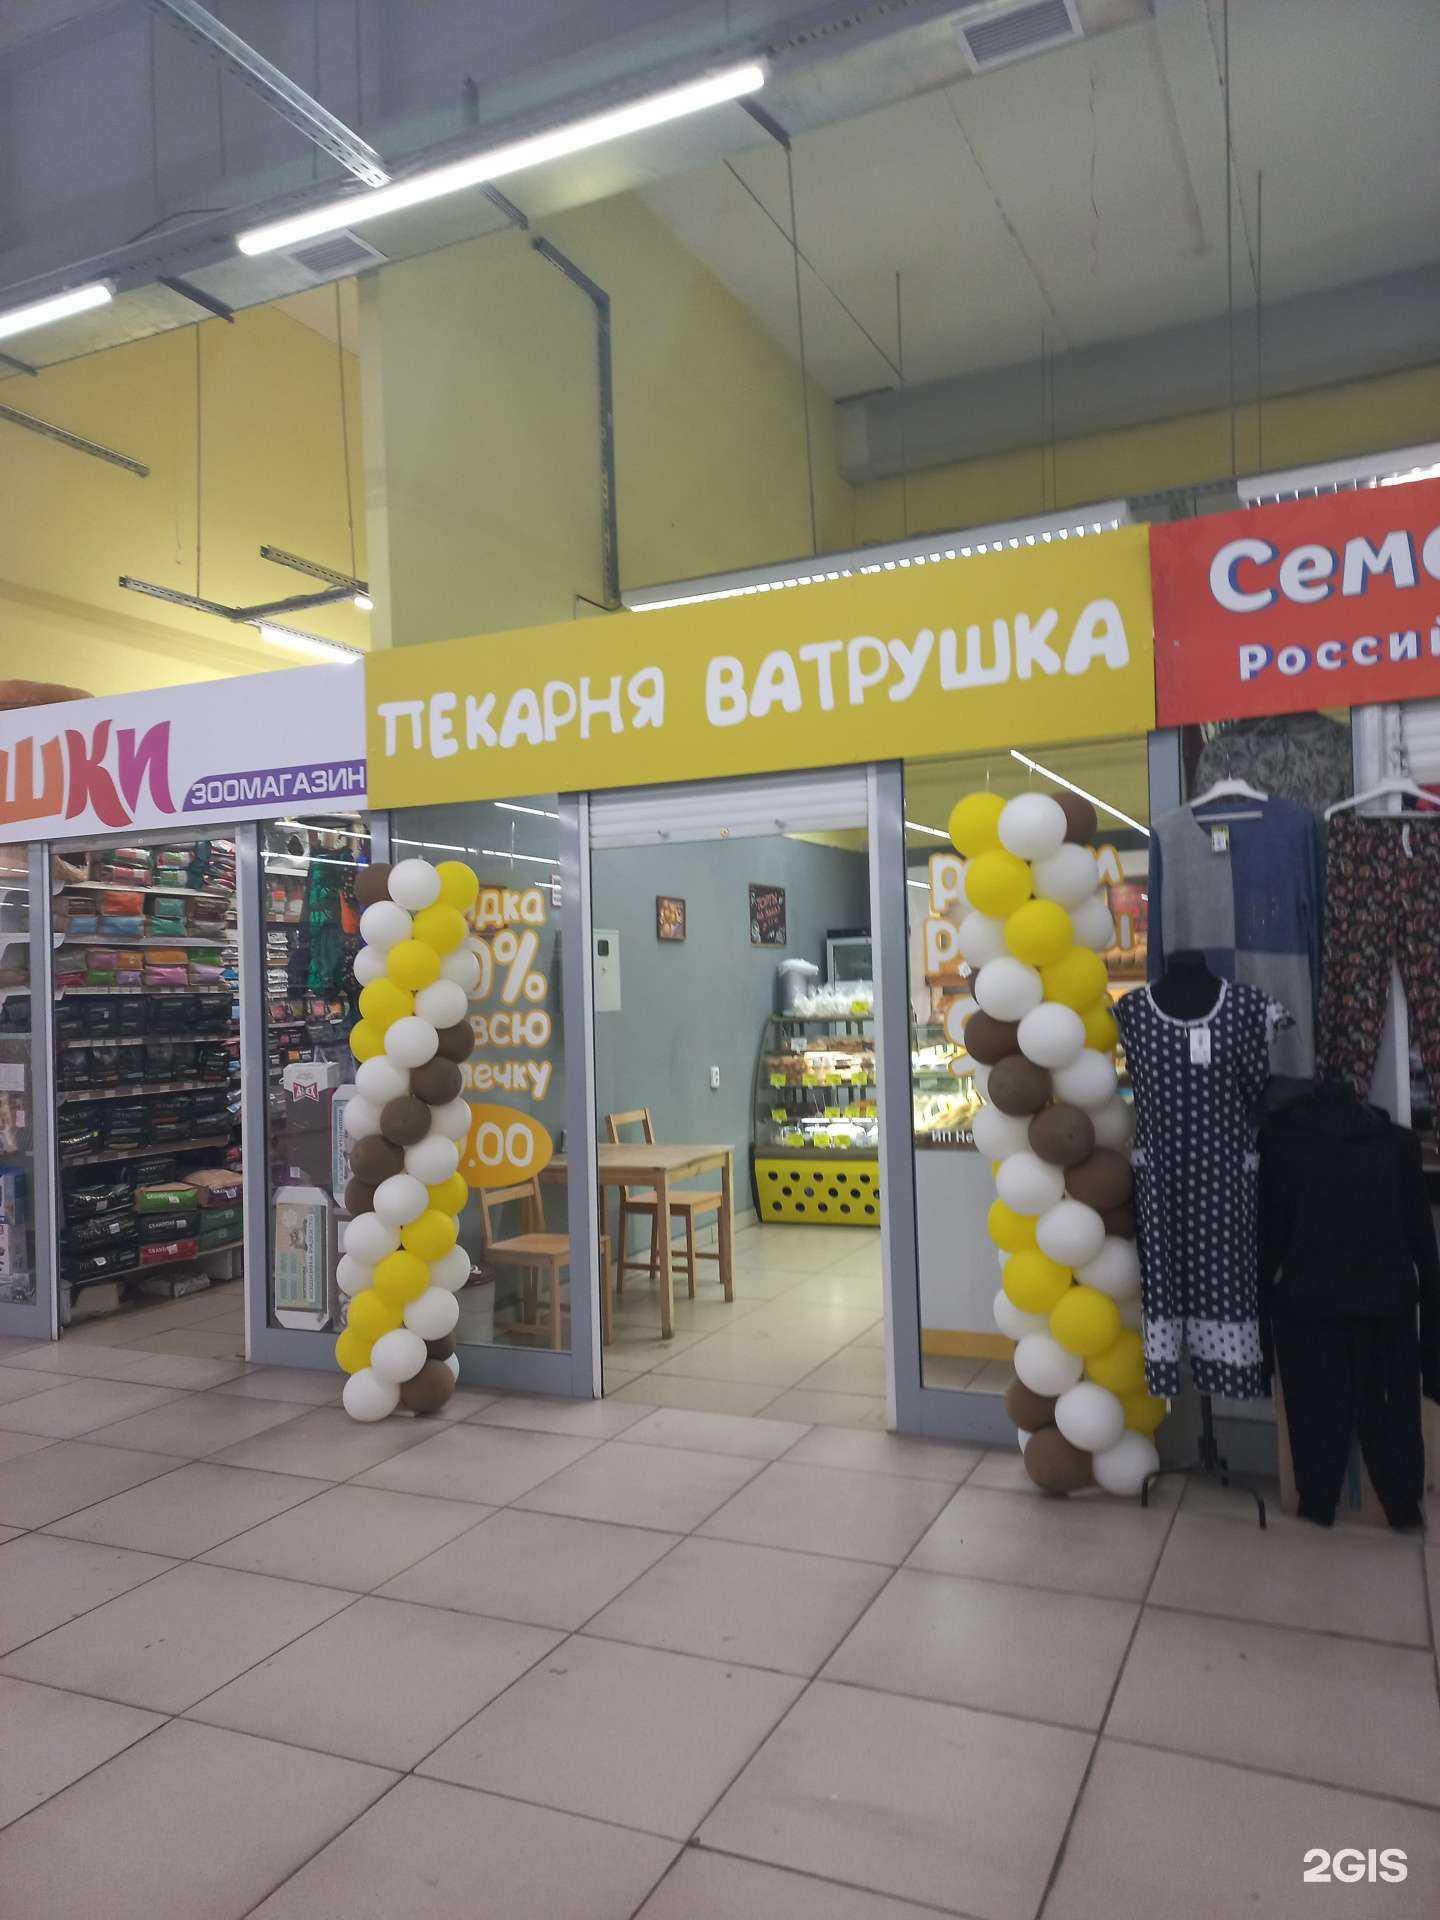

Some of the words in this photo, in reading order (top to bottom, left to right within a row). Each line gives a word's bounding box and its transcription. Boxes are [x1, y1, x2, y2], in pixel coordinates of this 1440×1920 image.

[377, 666, 665, 759] ПЕКАРНЯ
[705, 598, 1130, 727] ВАТРУШКА
[191, 766, 366, 805] ЗООМАГАЗИН
[464, 889, 545, 931] дка
